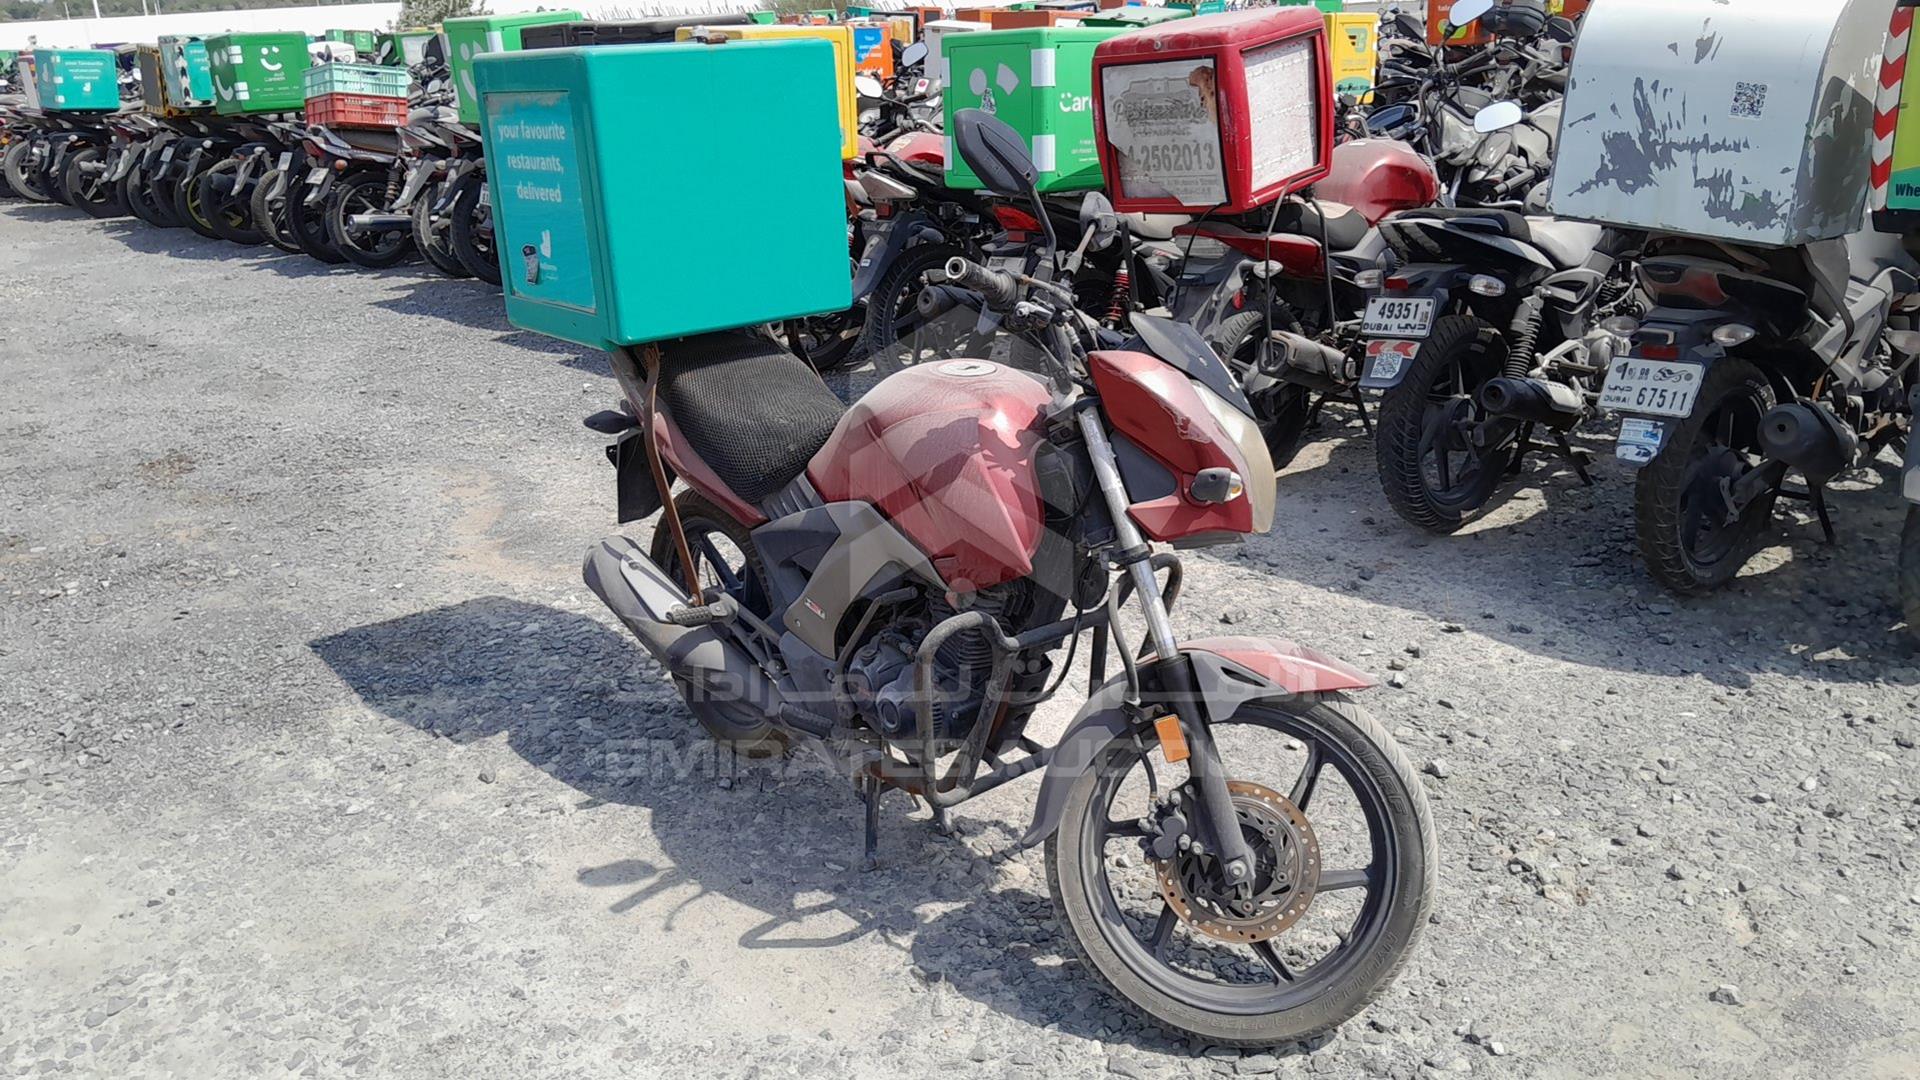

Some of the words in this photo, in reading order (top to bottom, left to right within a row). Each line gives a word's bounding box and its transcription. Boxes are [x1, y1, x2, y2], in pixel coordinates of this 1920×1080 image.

[498, 123, 519, 142] your
[522, 121, 565, 140] favourite
[508, 155, 563, 174] restaurants,
[516, 181, 562, 202] delivered
[1378, 302, 1420, 319] 49351
[1362, 322, 1393, 331] DUBAI
[1636, 387, 1687, 410] 67511
